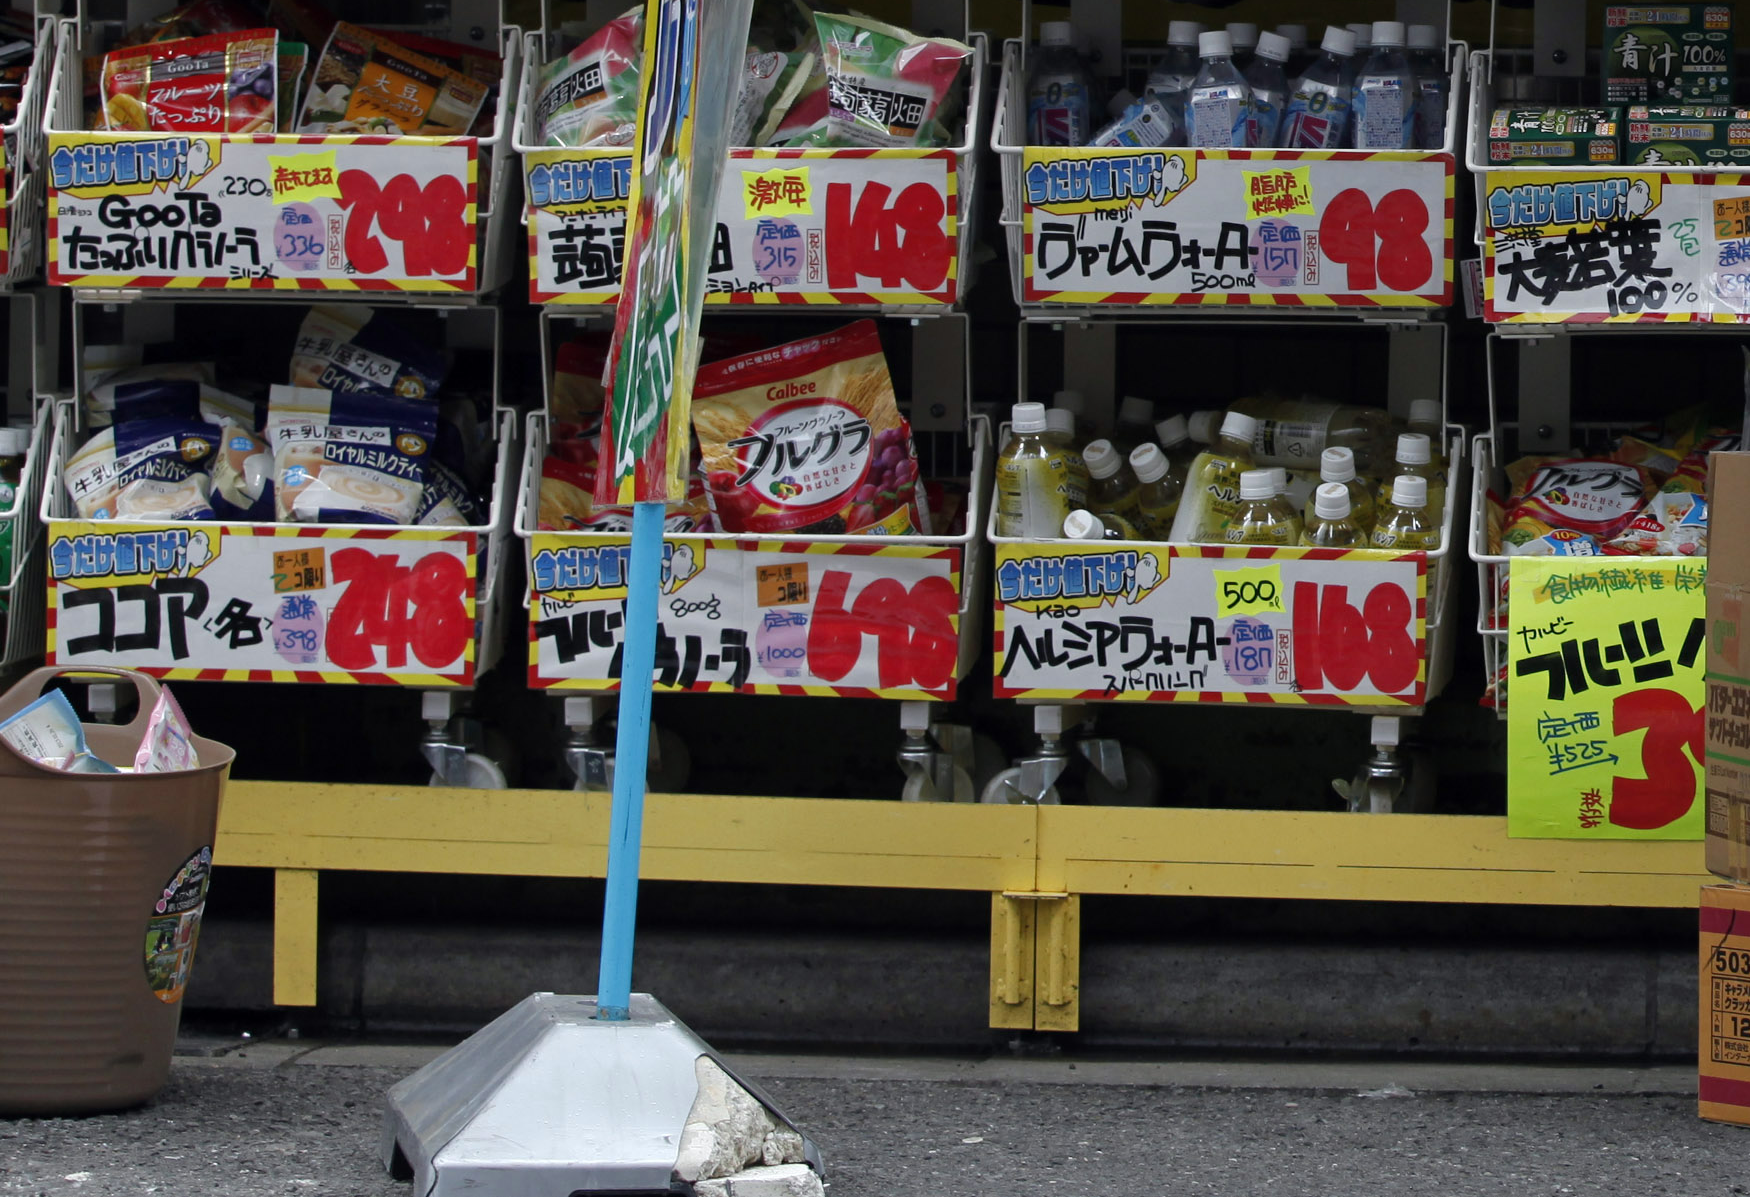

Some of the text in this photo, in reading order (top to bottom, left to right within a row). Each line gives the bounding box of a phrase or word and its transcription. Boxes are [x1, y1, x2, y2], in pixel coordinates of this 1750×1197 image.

[167, 60, 210, 74] GooTa
[1614, 33, 1679, 77] 青汁
[1683, 45, 1726, 64] 100%
[150, 83, 223, 105] フルーツ
[149, 105, 222, 126] たっぷり
[1252, 172, 1297, 197] 脂肪
[99, 192, 222, 229] GooTa
[337, 169, 467, 277] 298
[1095, 205, 1133, 222] meiji
[756, 220, 802, 244] 定価
[826, 181, 952, 292] 148
[1319, 188, 1433, 291] 98
[766, 381, 817, 402] Calbee
[728, 419, 872, 488] フルグラ
[63, 578, 210, 660] ココア
[325, 546, 468, 670] 248
[1036, 605, 1081, 620] Kao
[807, 569, 958, 690] 698
[1292, 581, 1420, 694] 168
[1516, 617, 1574, 653] カルビー
[1537, 711, 1600, 744] 定価
